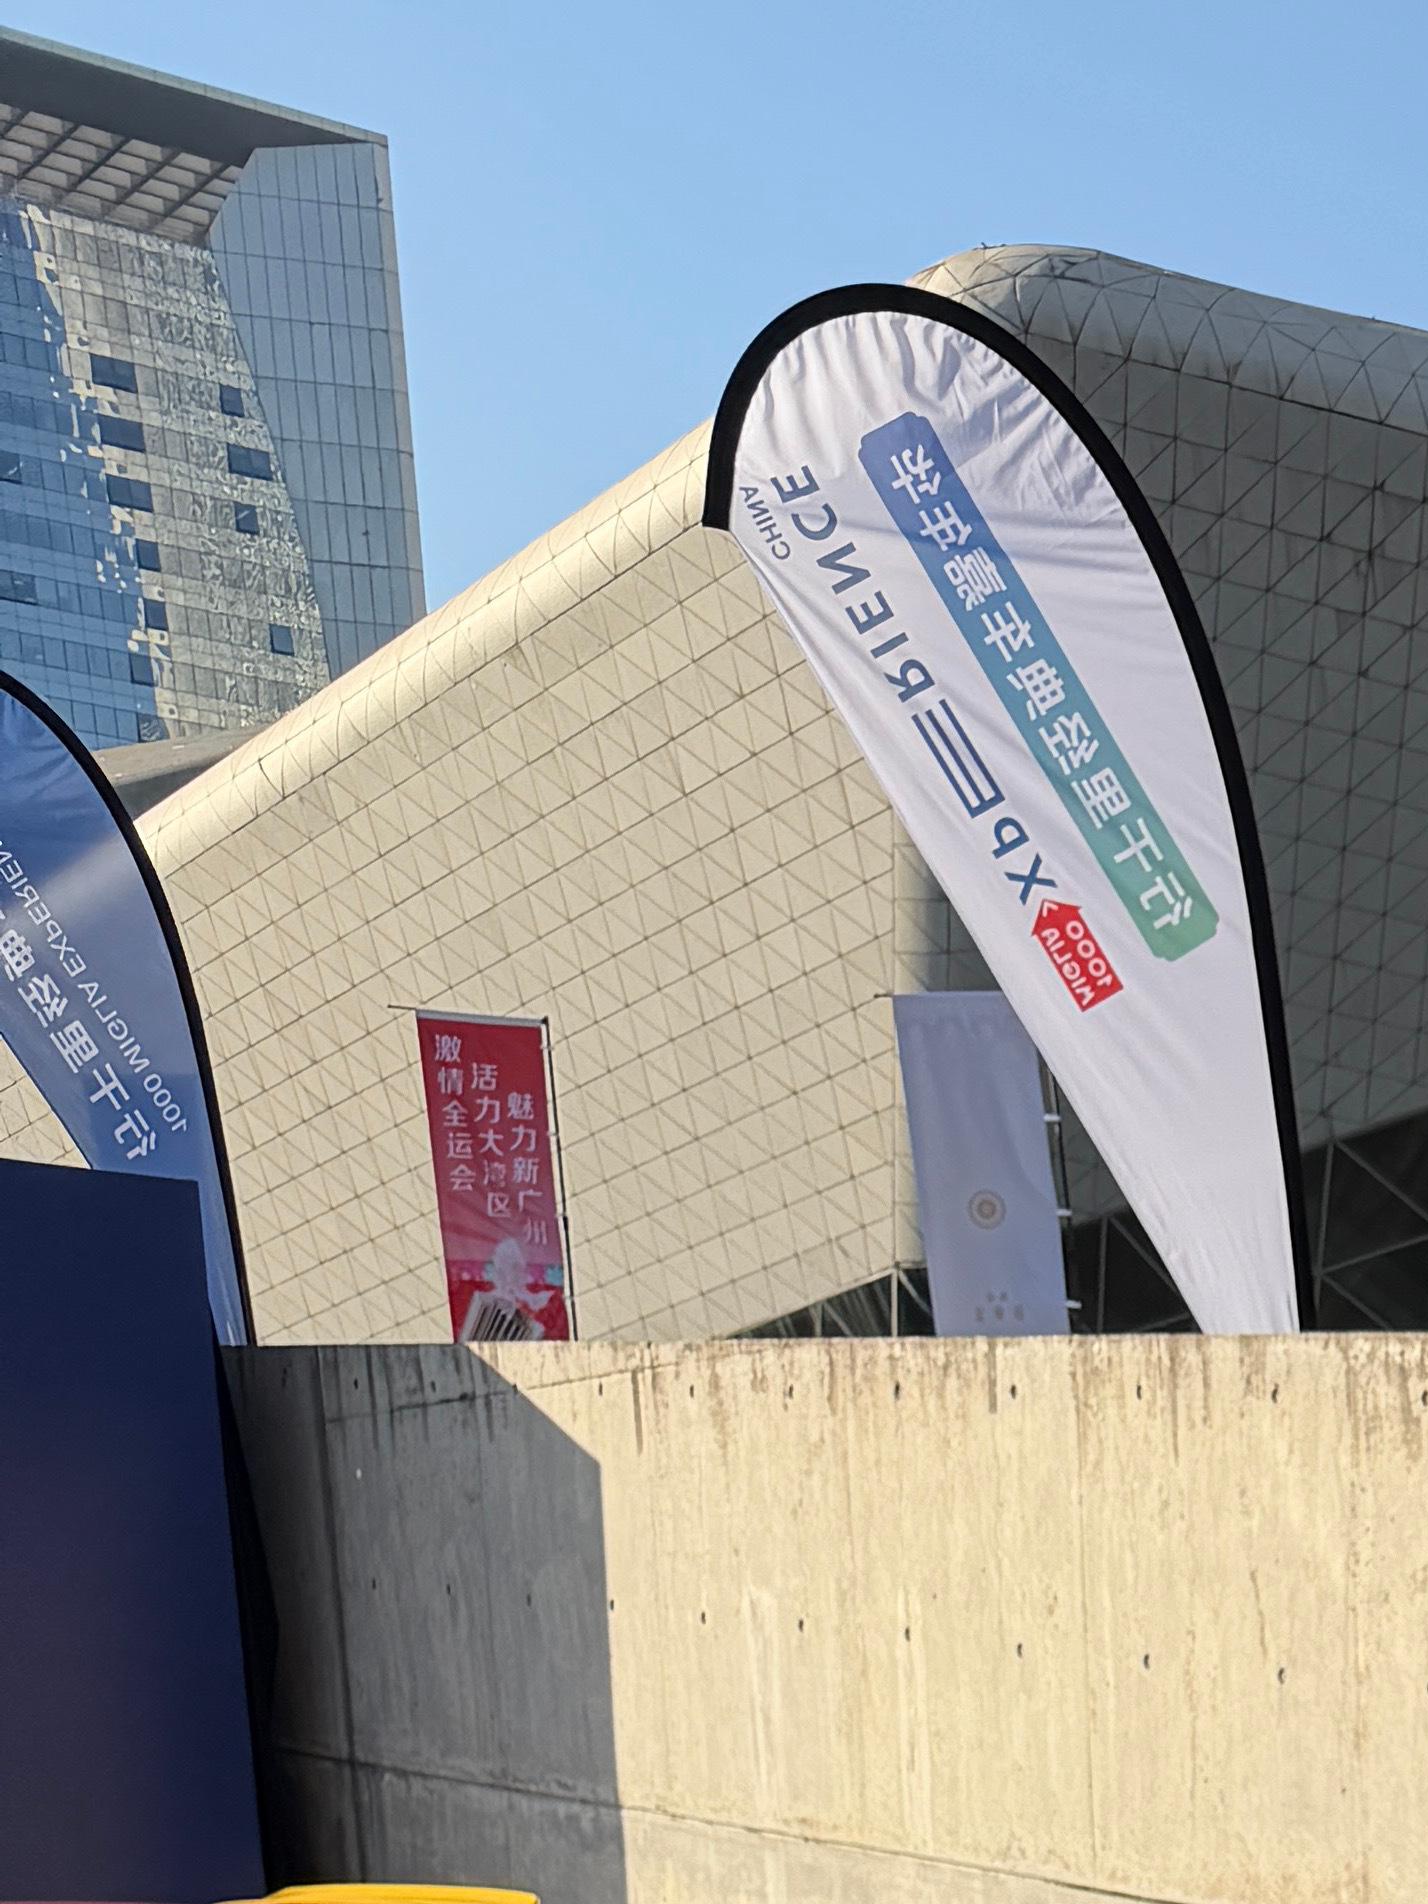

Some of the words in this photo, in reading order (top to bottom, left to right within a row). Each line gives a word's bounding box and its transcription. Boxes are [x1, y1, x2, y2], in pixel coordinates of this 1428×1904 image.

[434, 1033, 477, 1193] 激情全运会
[470, 1061, 512, 1219] 活力大湾区
[506, 1091, 549, 1247] 魅力新广州
